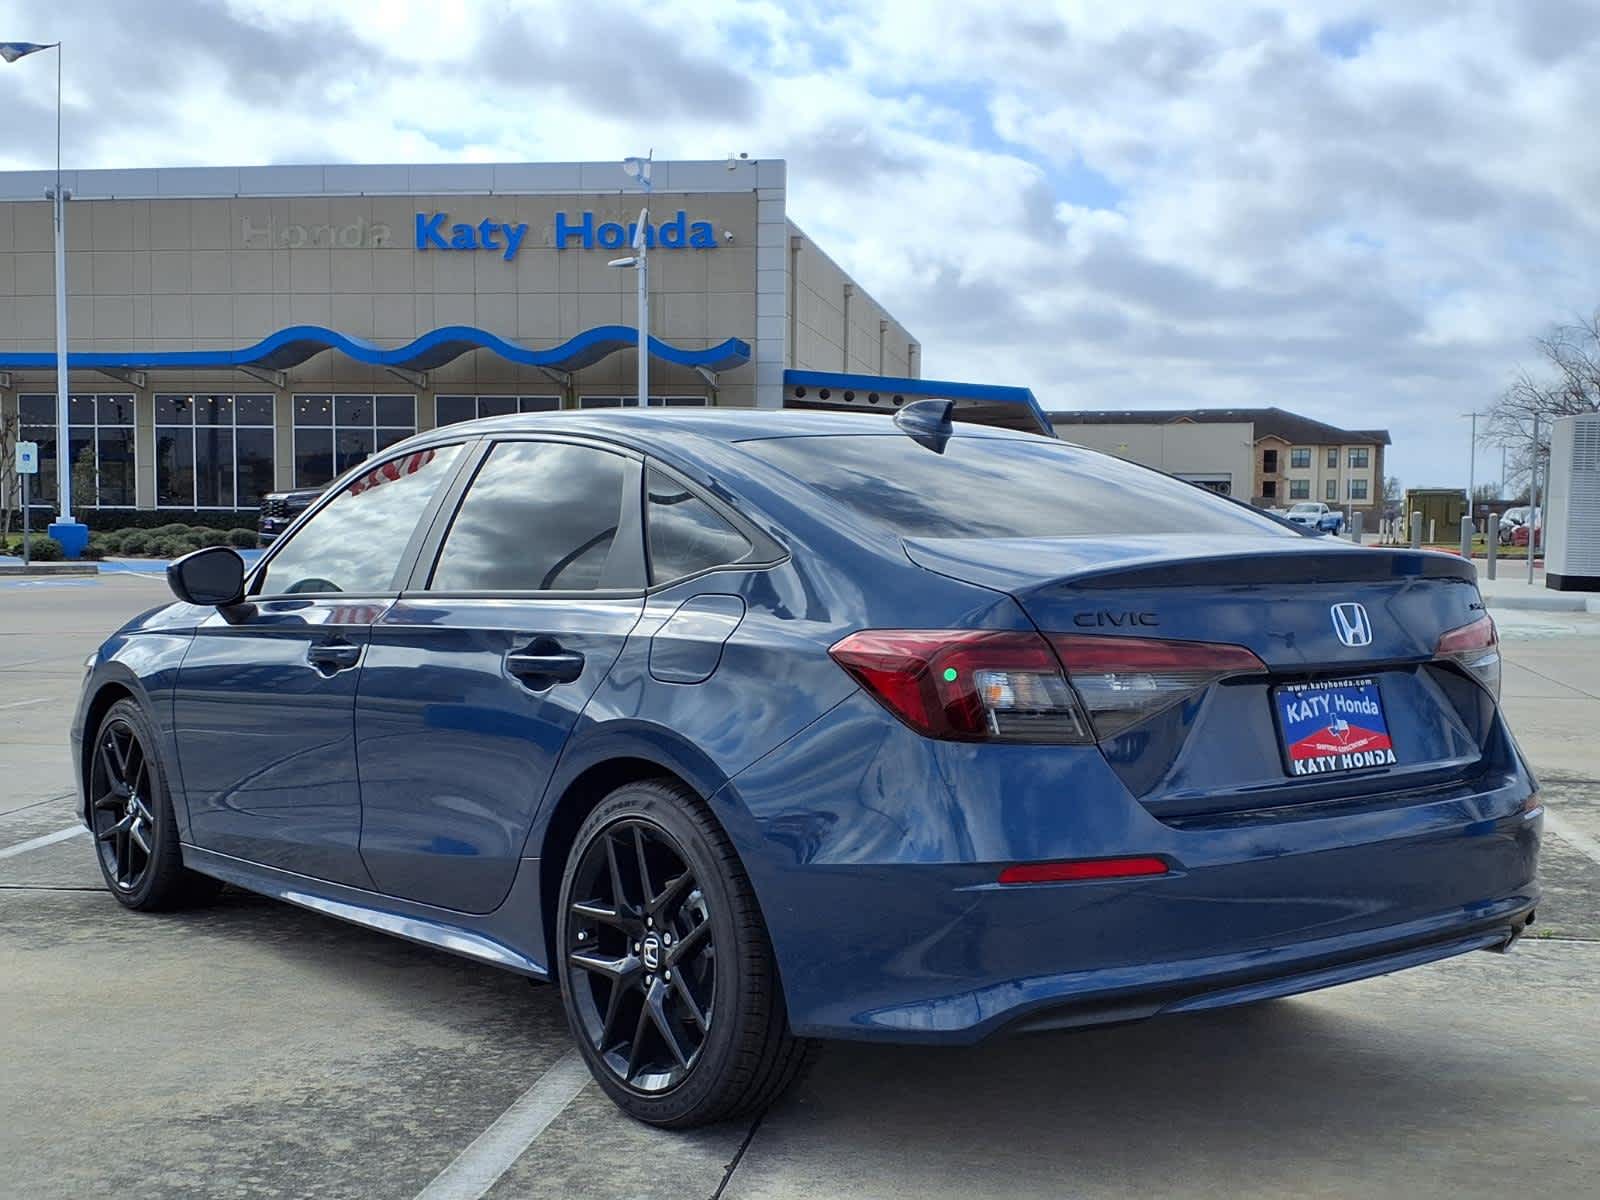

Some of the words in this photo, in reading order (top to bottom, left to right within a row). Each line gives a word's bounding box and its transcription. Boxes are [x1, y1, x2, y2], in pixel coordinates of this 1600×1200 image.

[415, 211, 528, 260] Katy
[555, 210, 718, 249] Honda
[1073, 611, 1160, 627] CIVIC
[1287, 679, 1372, 691] www.katyhonda.com
[1286, 693, 1330, 724] KATY
[1334, 693, 1379, 715] Honda
[1294, 755, 1337, 775] KATY
[1341, 748, 1397, 769] HONDA
